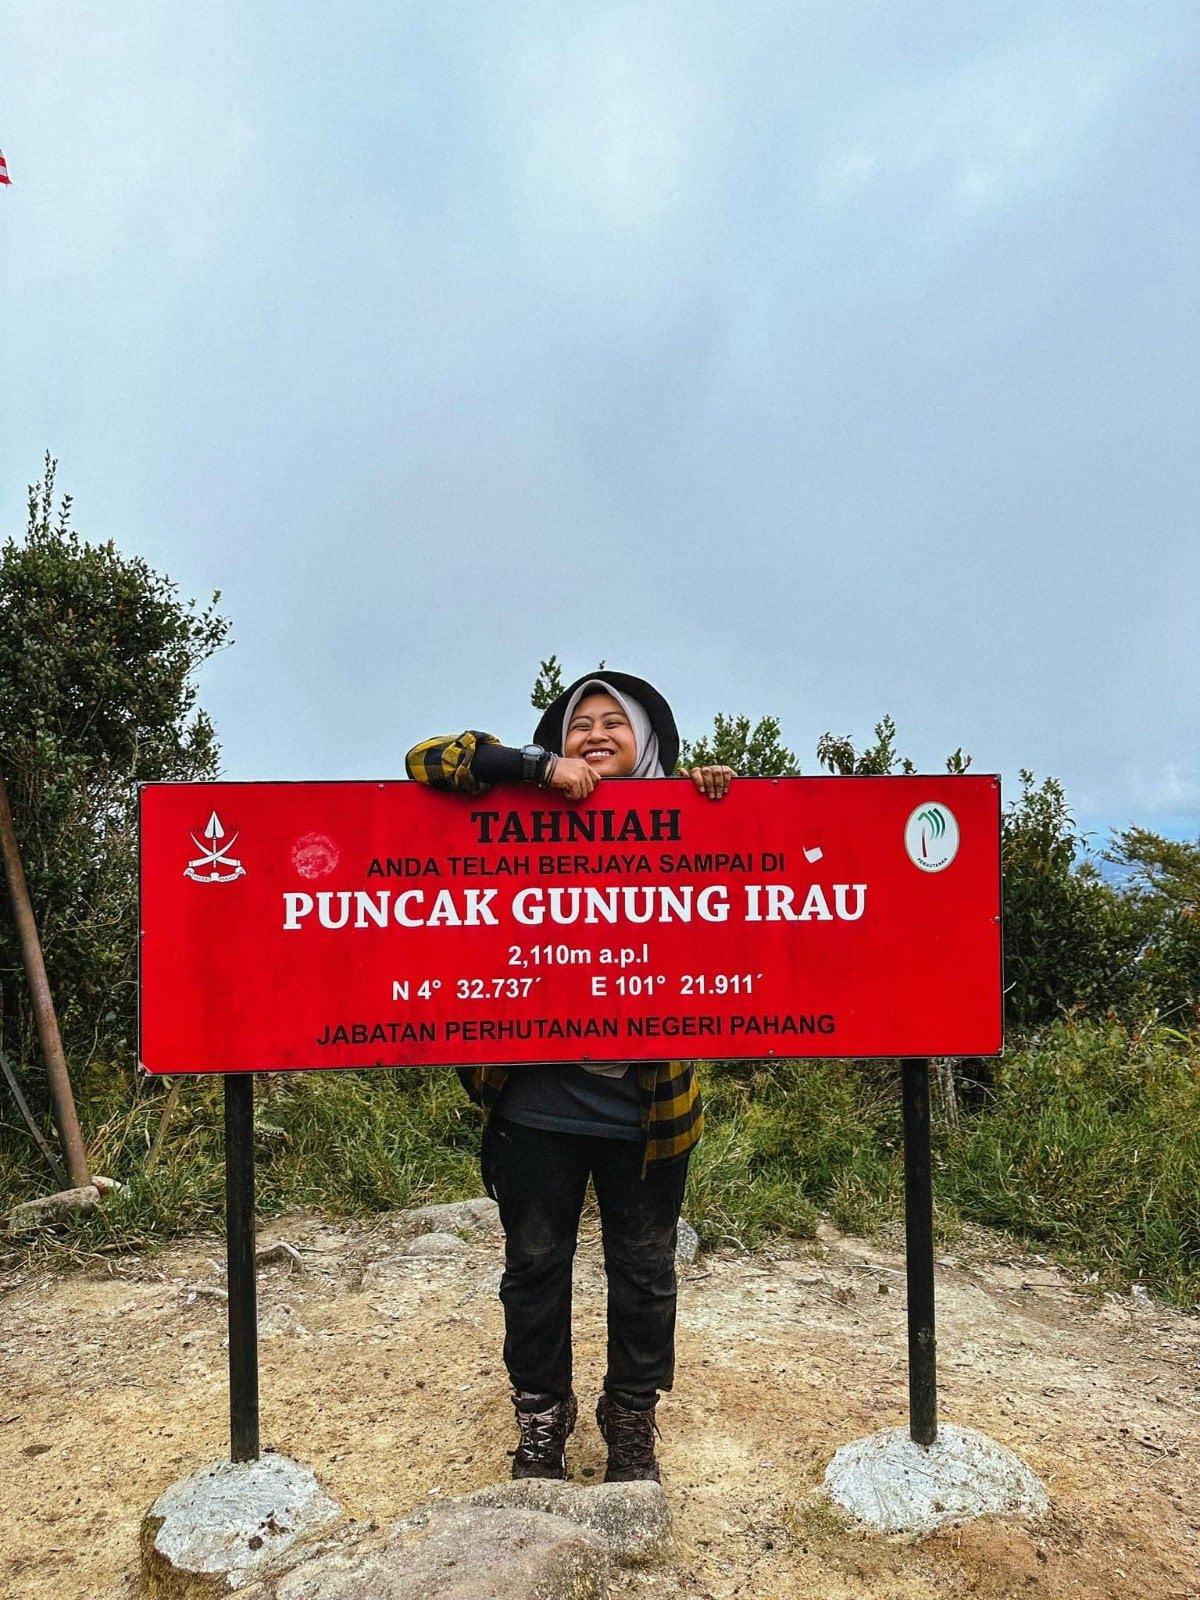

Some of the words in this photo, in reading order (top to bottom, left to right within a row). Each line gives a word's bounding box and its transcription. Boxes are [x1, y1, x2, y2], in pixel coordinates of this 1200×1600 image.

[471, 809, 681, 843] TAHNIAH
[368, 858, 440, 876] ANDA
[448, 857, 529, 875] TELAH
[539, 856, 651, 874] BERJAYA
[660, 854, 752, 873] SAMPAI
[762, 854, 784, 871] DI
[283, 889, 498, 929] PUNCAK
[512, 886, 730, 924] GUNUNG
[745, 884, 867, 921] IRAU
[509, 945, 591, 968] 2,110m
[600, 944, 647, 968] a.p.l
[393, 981, 408, 1000] N
[418, 980, 441, 999] 4°
[592, 977, 606, 995] E
[616, 976, 665, 995] 101°
[318, 1024, 435, 1045] JABATAN
[446, 1019, 617, 1040] PERHUTANAN
[628, 1017, 721, 1036] NEGERI
[731, 1015, 834, 1034] PAHANG
